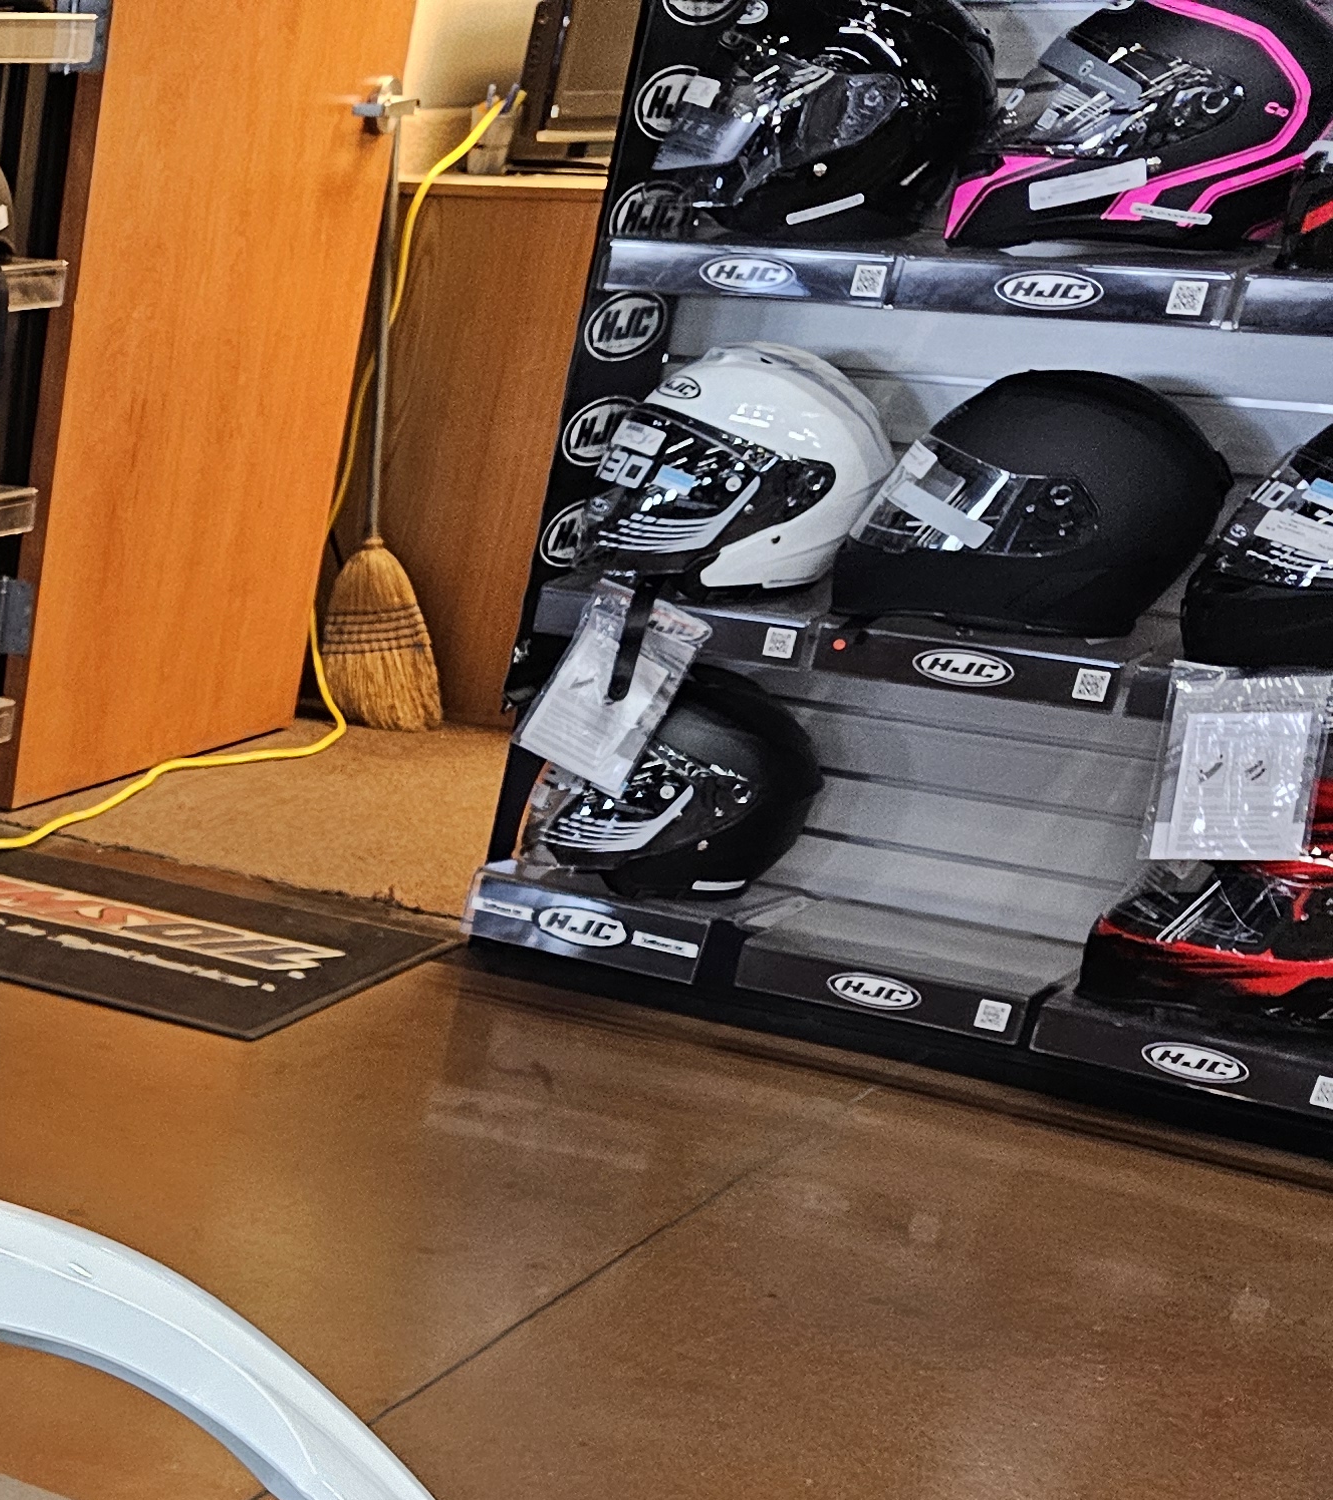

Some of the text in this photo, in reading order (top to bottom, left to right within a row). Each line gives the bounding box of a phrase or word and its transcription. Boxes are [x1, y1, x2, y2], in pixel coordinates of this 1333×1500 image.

[712, 264, 782, 283] HJC
[1009, 280, 1089, 299] HJC
[597, 305, 659, 341] HJC
[928, 657, 1000, 679] HJC
[546, 912, 618, 941] HJC
[841, 980, 909, 1004] HJC
[1158, 1050, 1237, 1078] HJC
